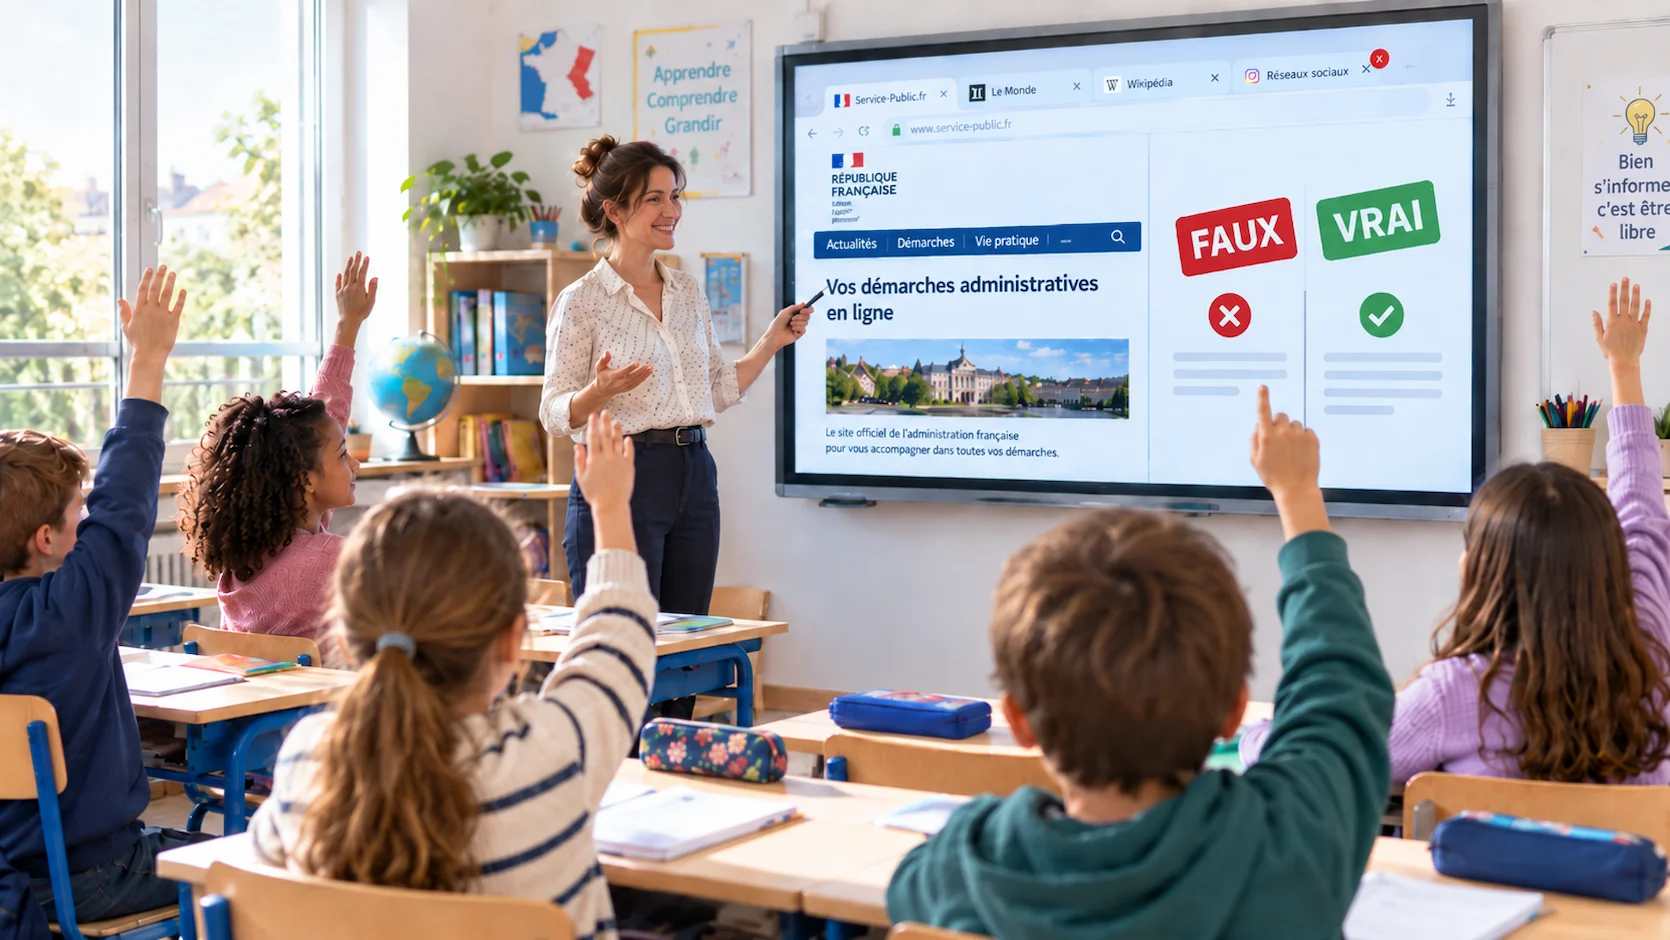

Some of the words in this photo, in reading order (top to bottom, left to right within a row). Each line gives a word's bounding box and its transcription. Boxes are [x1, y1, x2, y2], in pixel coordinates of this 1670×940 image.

[654, 61, 731, 85] Apprendre
[1268, 69, 1308, 80] Réseaux
[1312, 66, 1348, 77] sociaux
[992, 87, 1002, 97] Le
[1005, 84, 1036, 95] Monde
[1127, 77, 1172, 90] Wikipédia
[647, 86, 738, 111] Comprendre
[856, 90, 926, 104] Service-Public.fr
[665, 115, 722, 134] Grandir
[910, 119, 1012, 134] www.service-public.fr
[1620, 153, 1653, 169] Bien
[832, 172, 897, 184] RÉPUBLIQUE
[832, 185, 896, 198] FRANÇAISE
[1598, 202, 1635, 217] c'est
[1641, 200, 1670, 215] être
[1333, 199, 1424, 243] VRAI
[1190, 214, 1284, 259] FAUX
[1620, 224, 1655, 239] libre
[826, 237, 877, 249] Actualités
[898, 235, 955, 248] Démarches
[975, 234, 992, 246] Vie
[995, 235, 1039, 249] pratique
[826, 279, 856, 295] Vos
[861, 276, 955, 294] démarches
[960, 274, 1098, 293] administratives
[827, 308, 847, 320] en
[853, 303, 893, 325] ligne
[826, 427, 835, 438] Le
[838, 427, 853, 438] site
[857, 427, 886, 438] officiel
[889, 428, 900, 439] de
[903, 428, 974, 439] l'administration
[977, 429, 1019, 442] française
[825, 443, 846, 454] pour
[848, 445, 868, 454] vous
[871, 445, 931, 457] accompagner
[933, 444, 954, 455] dans
[956, 446, 985, 456] toutes
[988, 448, 1003, 457] vos
[1006, 446, 1059, 457] démarches.
